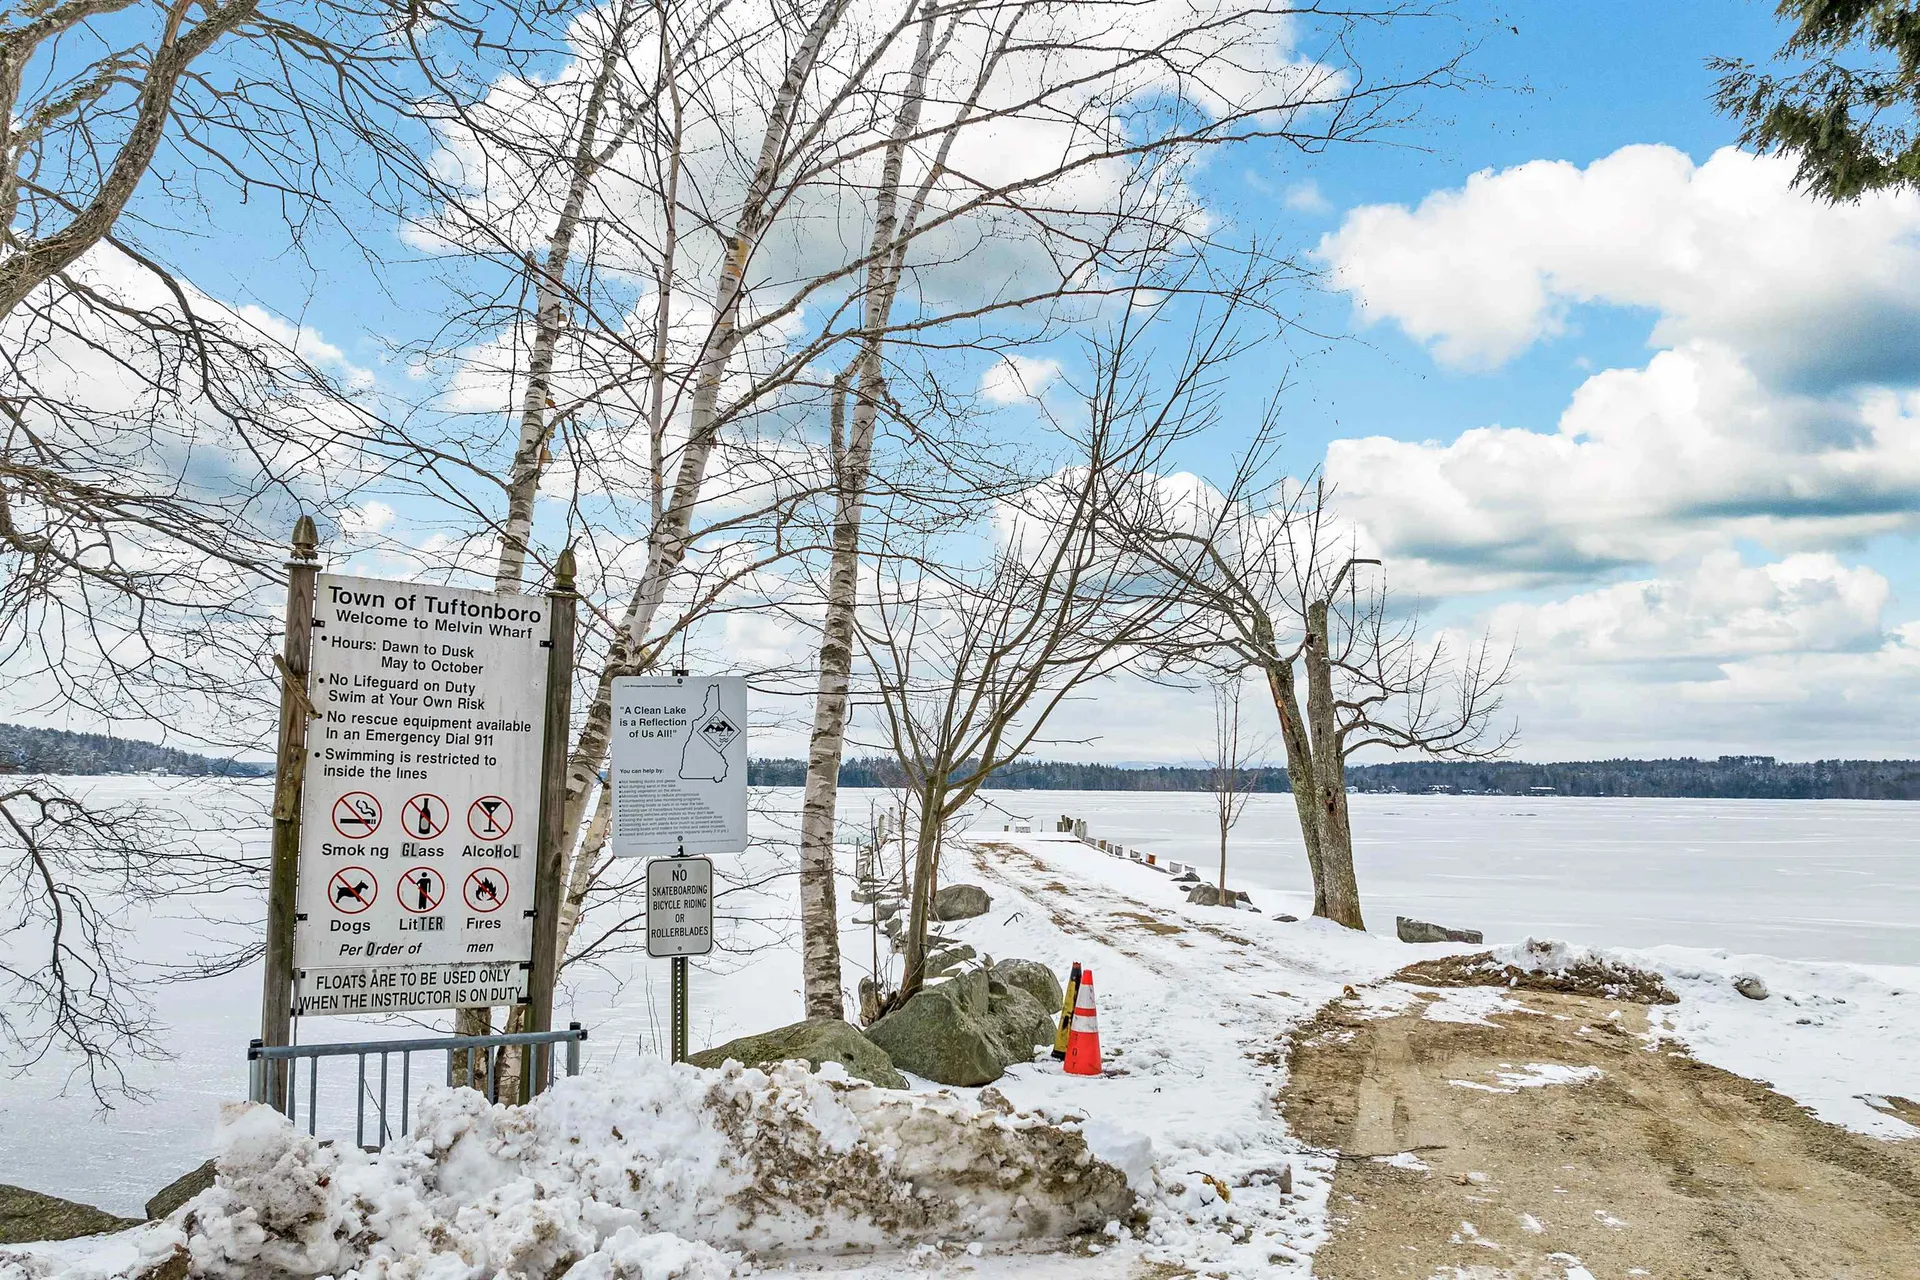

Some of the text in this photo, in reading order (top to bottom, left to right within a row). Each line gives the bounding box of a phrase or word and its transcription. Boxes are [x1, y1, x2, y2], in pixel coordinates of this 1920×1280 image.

[328, 586, 541, 623] Town of Tuftonboro
[336, 610, 533, 639] Welcome to Melvin Wharf
[331, 636, 474, 658] Hours: Dawn to Dusk
[381, 657, 483, 674] May to October
[329, 673, 475, 696] No Lifeguard on Duty
[328, 691, 485, 710] Swim at Your Own Risk
[634, 707, 661, 715] Clean
[327, 711, 531, 733] No rescue equipment available
[325, 727, 493, 746] In an Emergency Dial 911
[325, 748, 497, 766] Swimming is restricted to
[324, 765, 364, 777] inside
[370, 766, 391, 778] the
[672, 870, 687, 881] NO
[652, 885, 708, 896] SKATEBOARDING
[653, 899, 706, 910] BICYCLE RIDING
[330, 919, 371, 934] Dogs
[675, 914, 684, 922] OR
[652, 926, 708, 938] ROLLERBLADES
[339, 945, 363, 956] Per
[365, 941, 404, 957] Order
[408, 943, 423, 954] of
[316, 969, 511, 990] FLOATS ARE TO BE USED ONLY
[299, 986, 522, 1010] WHEN THE INSTRUCTOR IS ON DUTY
